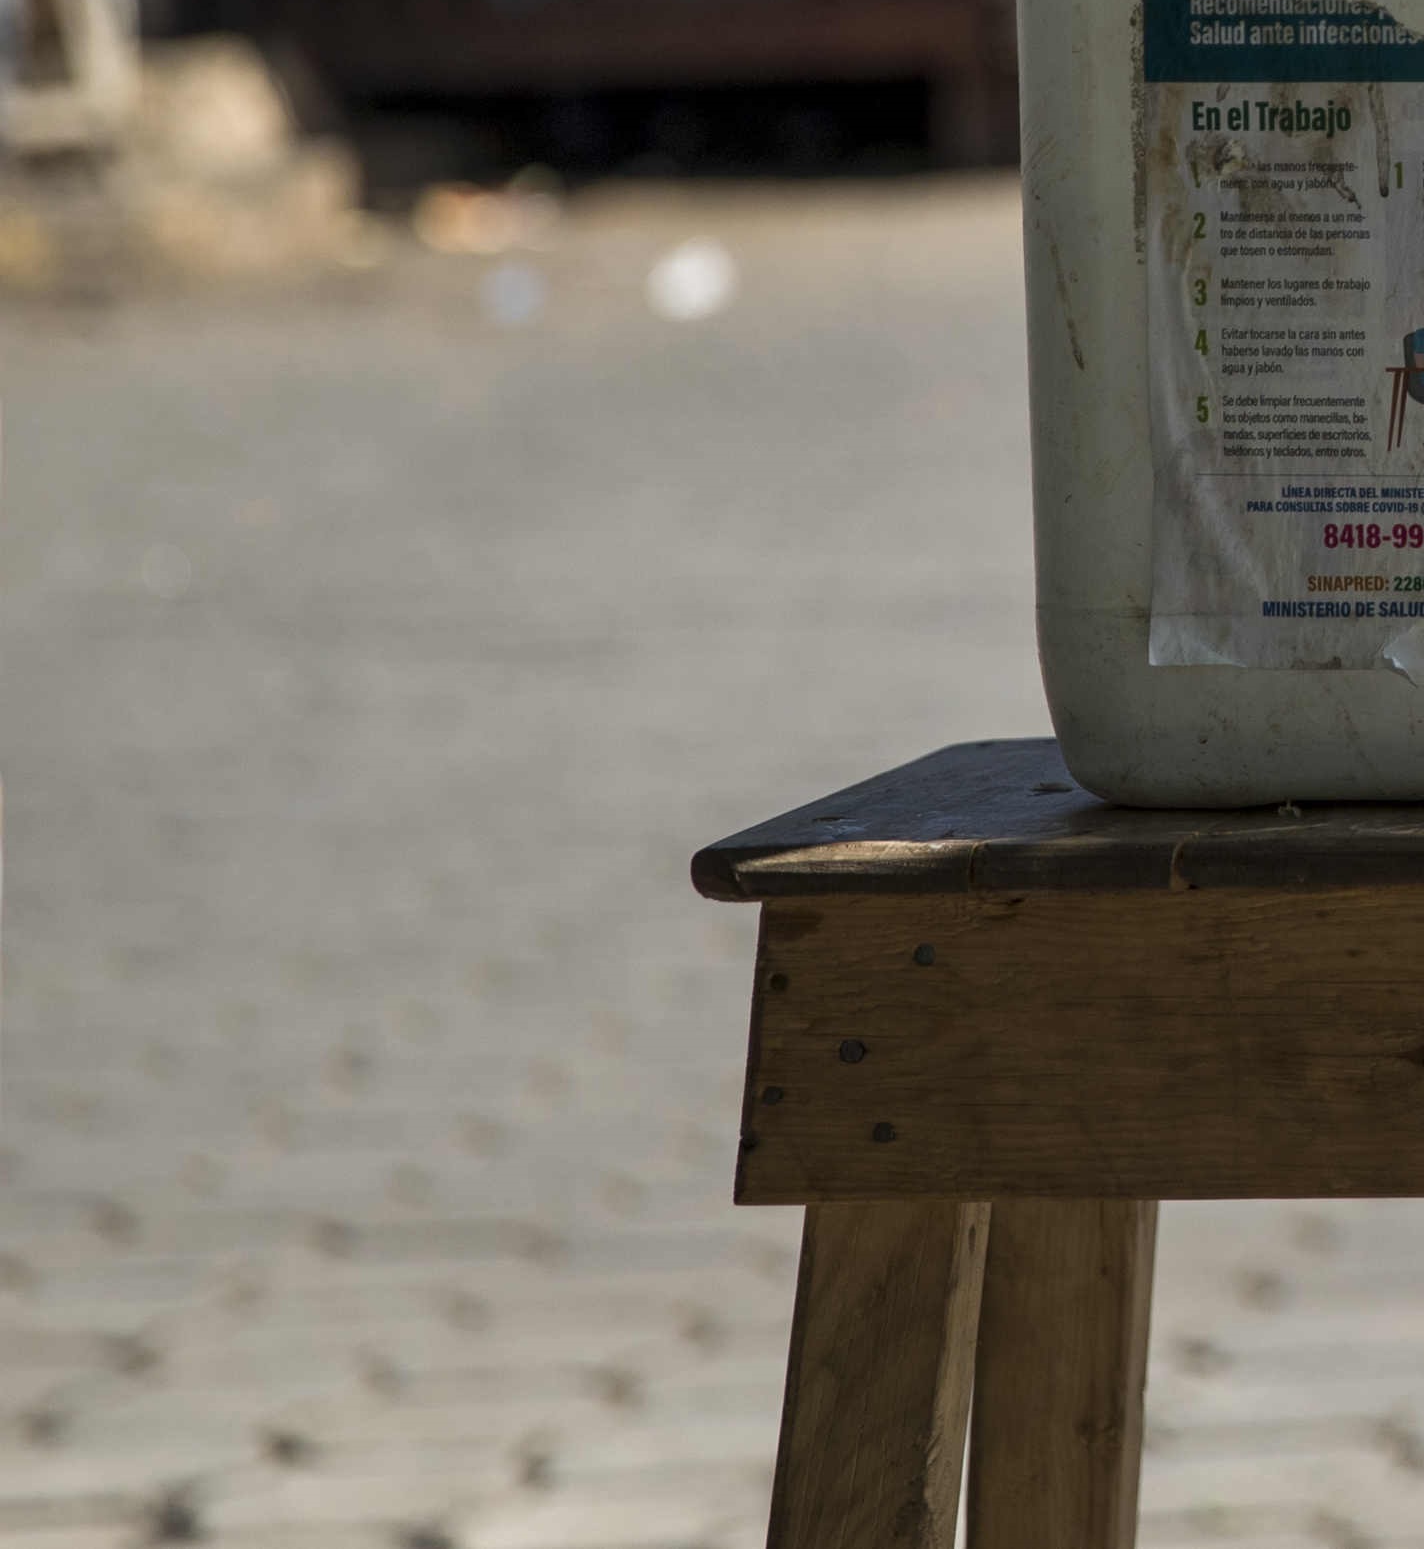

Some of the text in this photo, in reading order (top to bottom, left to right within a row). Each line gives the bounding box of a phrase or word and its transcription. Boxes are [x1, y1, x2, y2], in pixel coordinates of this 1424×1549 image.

[1190, 21, 1244, 45] Salud
[1250, 24, 1294, 45] ante
[1192, 100, 1351, 139] En el Trabajo
[1394, 162, 1404, 189] 1
[1271, 180, 1295, 192] agua
[1297, 180, 1304, 192] y
[1193, 212, 1206, 239] 2
[1323, 214, 1329, 222] a
[1332, 214, 1344, 222] un
[1220, 228, 1370, 242] tro de distancia de las personas
[1220, 248, 1238, 259] que
[1269, 248, 1275, 257] o
[1195, 279, 1371, 306] 3 Mantener los lugares de trabajo
[1220, 296, 1255, 308] limpios
[1257, 298, 1263, 309] y
[1195, 329, 1366, 356] 4 Evitar tocarse la cara sin antes
[1221, 346, 1364, 357] haberse lavado las manos con
[1222, 362, 1284, 376] agua y jabón.
[1196, 396, 1366, 423] 5 Se debe limpiar frecuentemente
[1223, 412, 1236, 424] los
[1272, 414, 1298, 424] como
[1308, 429, 1321, 441] de
[1266, 448, 1272, 460] y
[1281, 484, 1311, 499] LÍNEA
[1313, 487, 1357, 499] DIRECTA
[1359, 487, 1378, 499] DEL
[1247, 501, 1273, 513] PARA
[1275, 501, 1334, 513] CONSULTAS
[1336, 501, 1370, 513] SOBRE
[1372, 501, 1419, 513] COVID-19
[1307, 576, 1390, 592] SINAPRED:
[1262, 601, 1351, 618] MINISTERIO
[1355, 601, 1374, 618] DE
